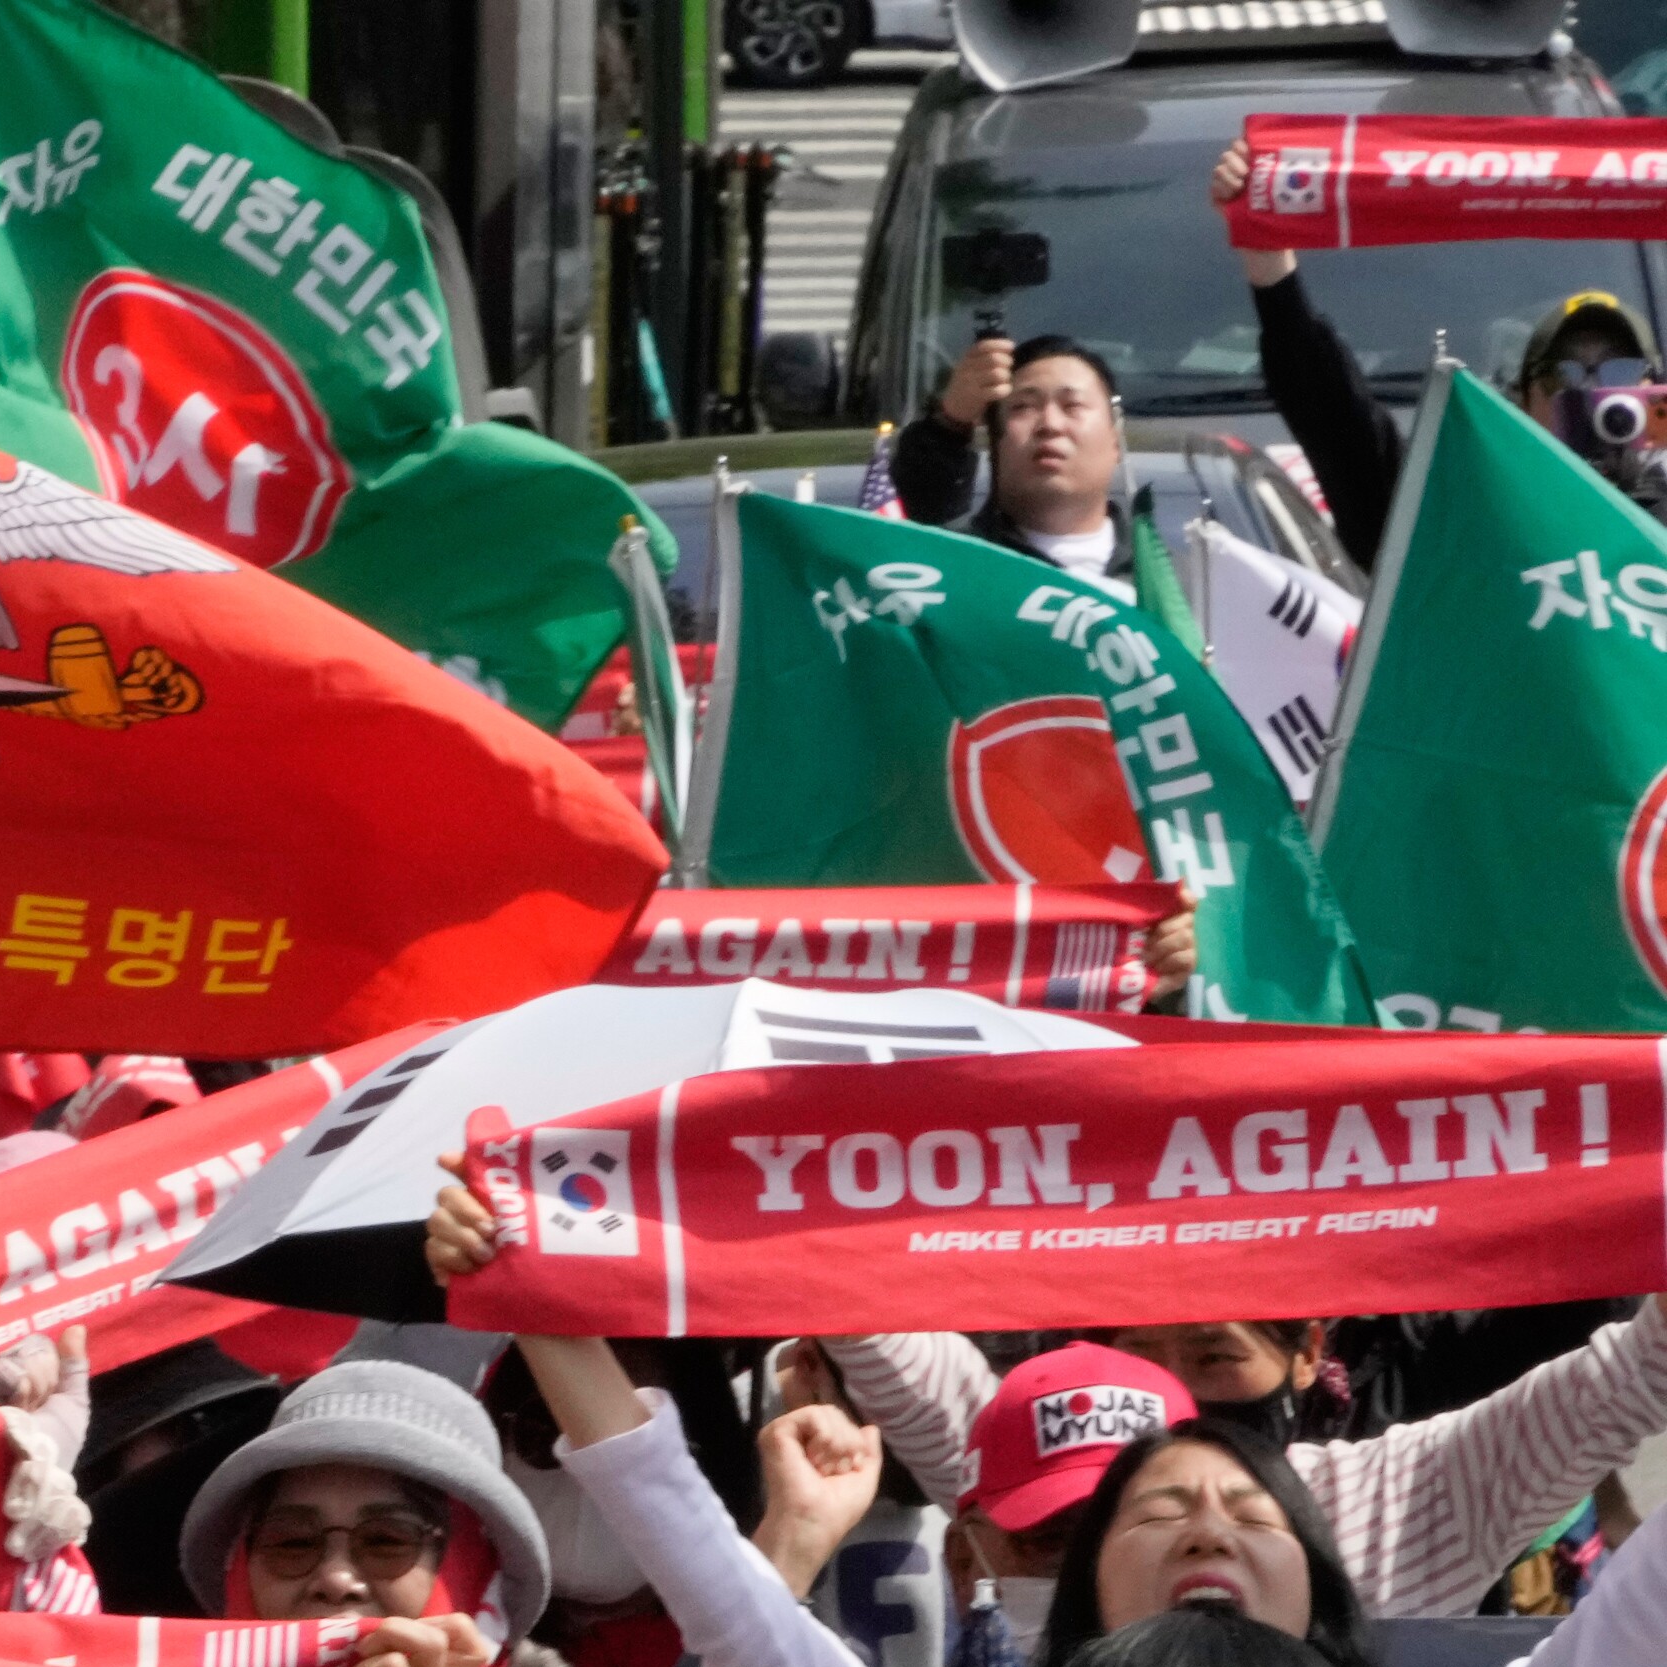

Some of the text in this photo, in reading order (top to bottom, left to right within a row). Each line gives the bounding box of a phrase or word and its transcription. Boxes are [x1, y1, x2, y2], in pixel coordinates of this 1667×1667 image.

[1379, 150, 1570, 190] YOON,
[151, 142, 441, 391] 대한민국
[633, 917, 932, 983] AGAIN
[732, 1122, 1116, 1214] YOON,
[1147, 1088, 1548, 1200] AGAIN
[482, 1132, 530, 1246] YOON
[907, 1205, 1439, 1253] MAKE KOREA GREAT AGAIN
[33, 1285, 127, 1332] GREAT
[1096, 1389, 1156, 1416] JAE
